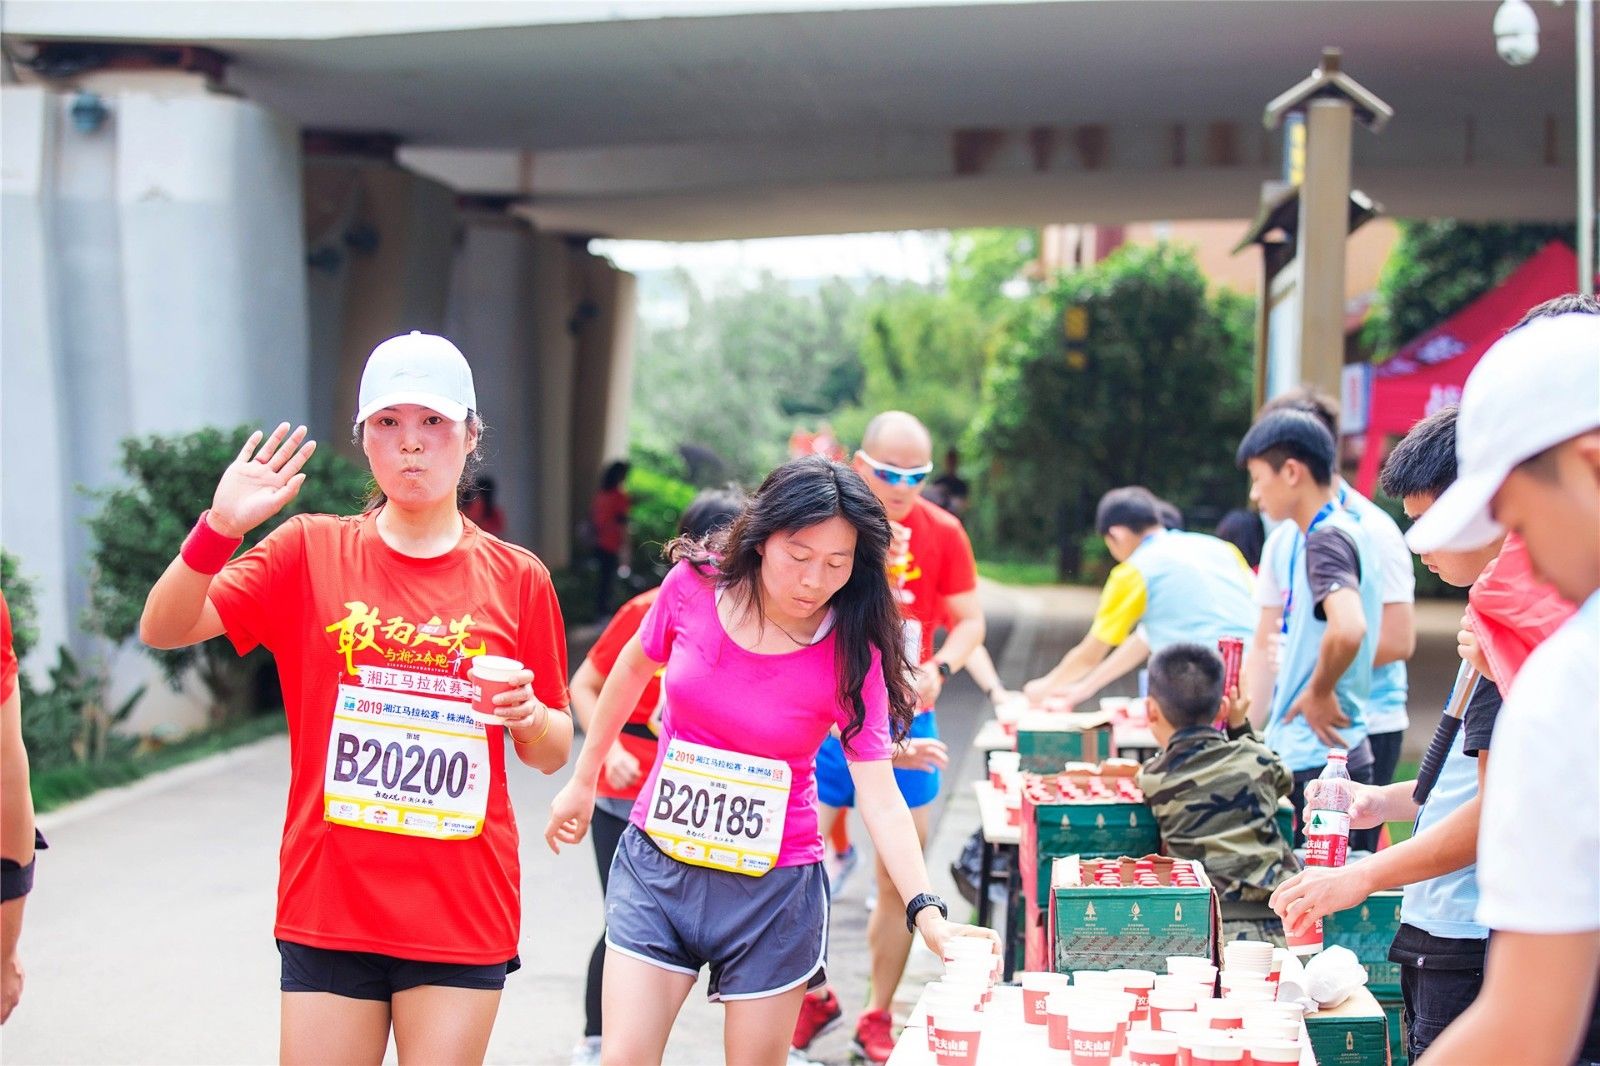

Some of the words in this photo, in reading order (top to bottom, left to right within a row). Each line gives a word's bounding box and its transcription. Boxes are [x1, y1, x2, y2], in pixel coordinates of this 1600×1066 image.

[384, 648, 449, 669] 与湘江奔跑
[366, 670, 463, 695] 湘江马拉松赛
[333, 732, 469, 799] B20200
[653, 778, 766, 839] B20185
